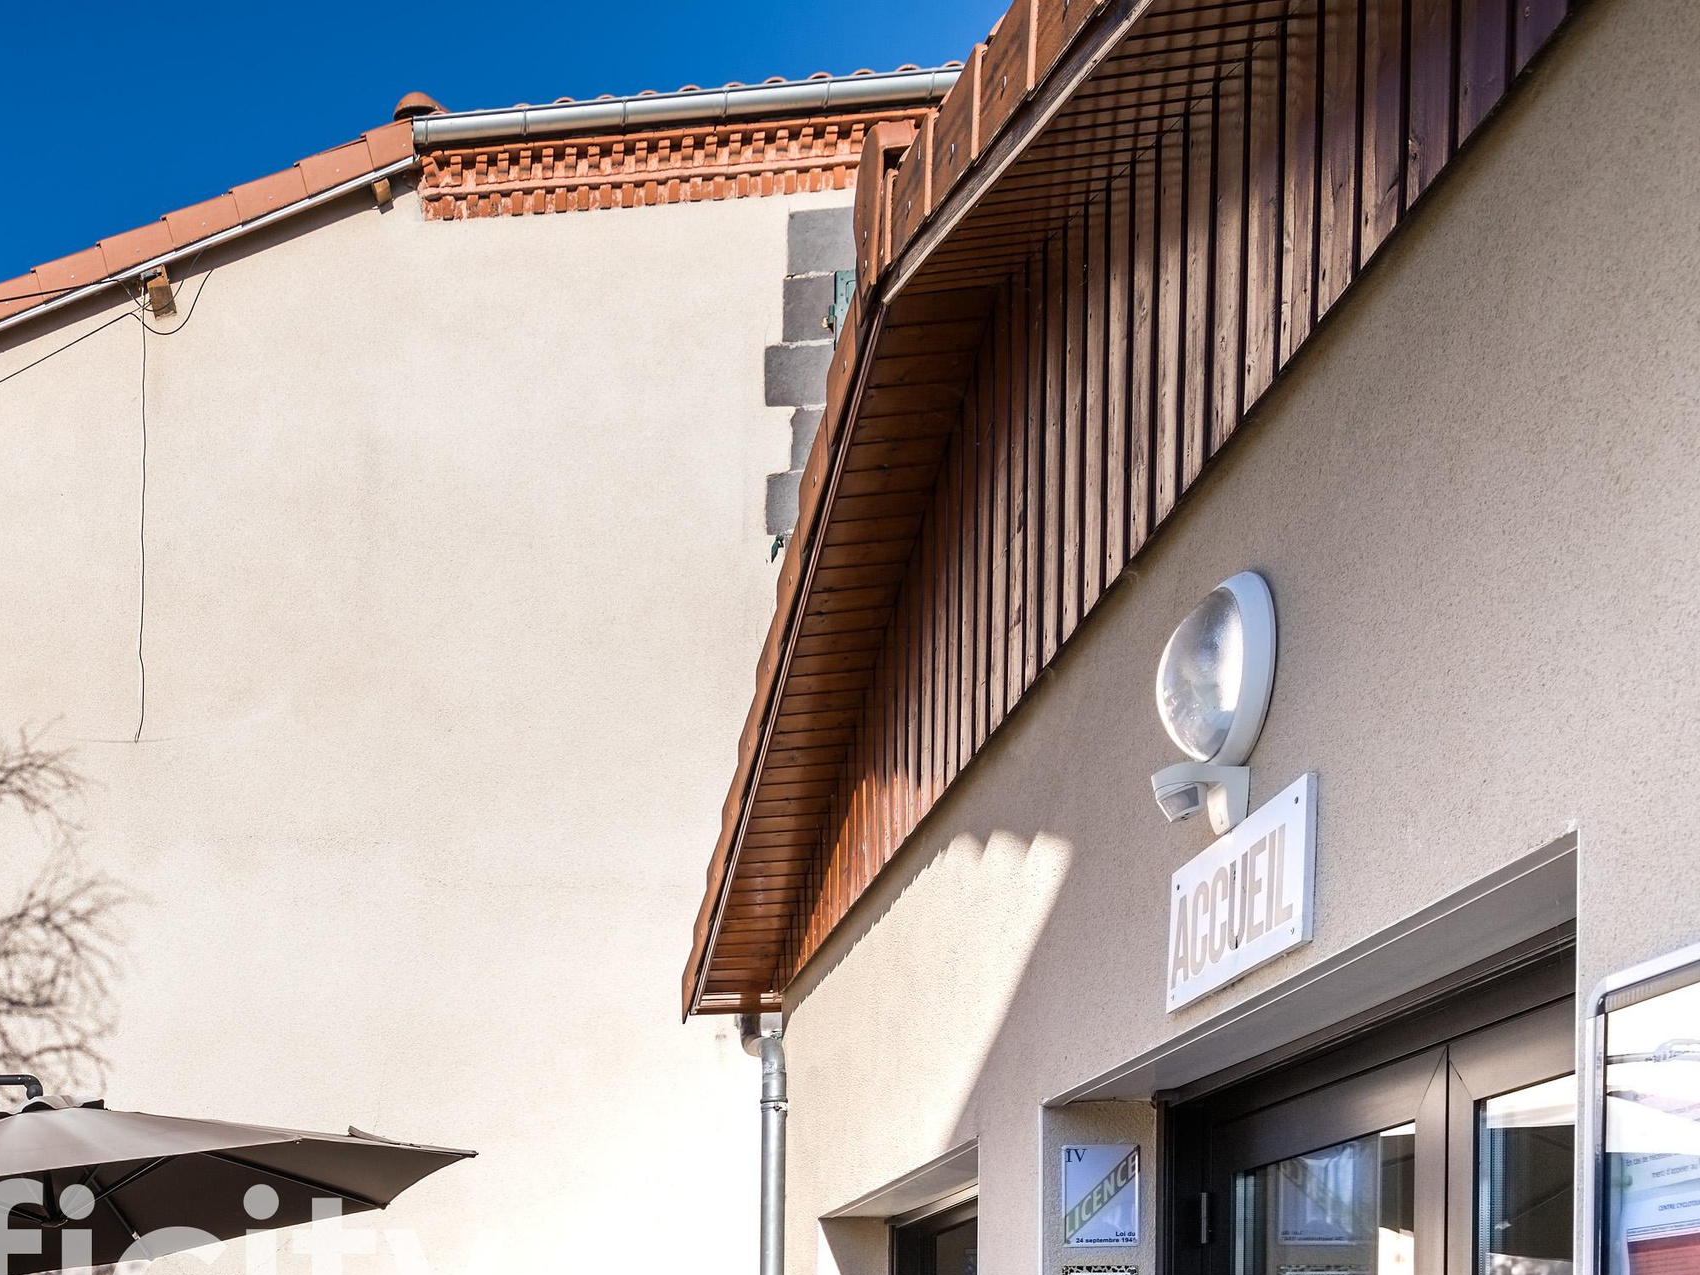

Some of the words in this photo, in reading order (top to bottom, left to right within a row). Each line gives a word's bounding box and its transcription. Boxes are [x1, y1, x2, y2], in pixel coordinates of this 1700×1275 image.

[1170, 823, 1293, 990] ACCUEIL
[1065, 1148, 1087, 1163] IV
[1065, 1149, 1137, 1240] LICENCE
